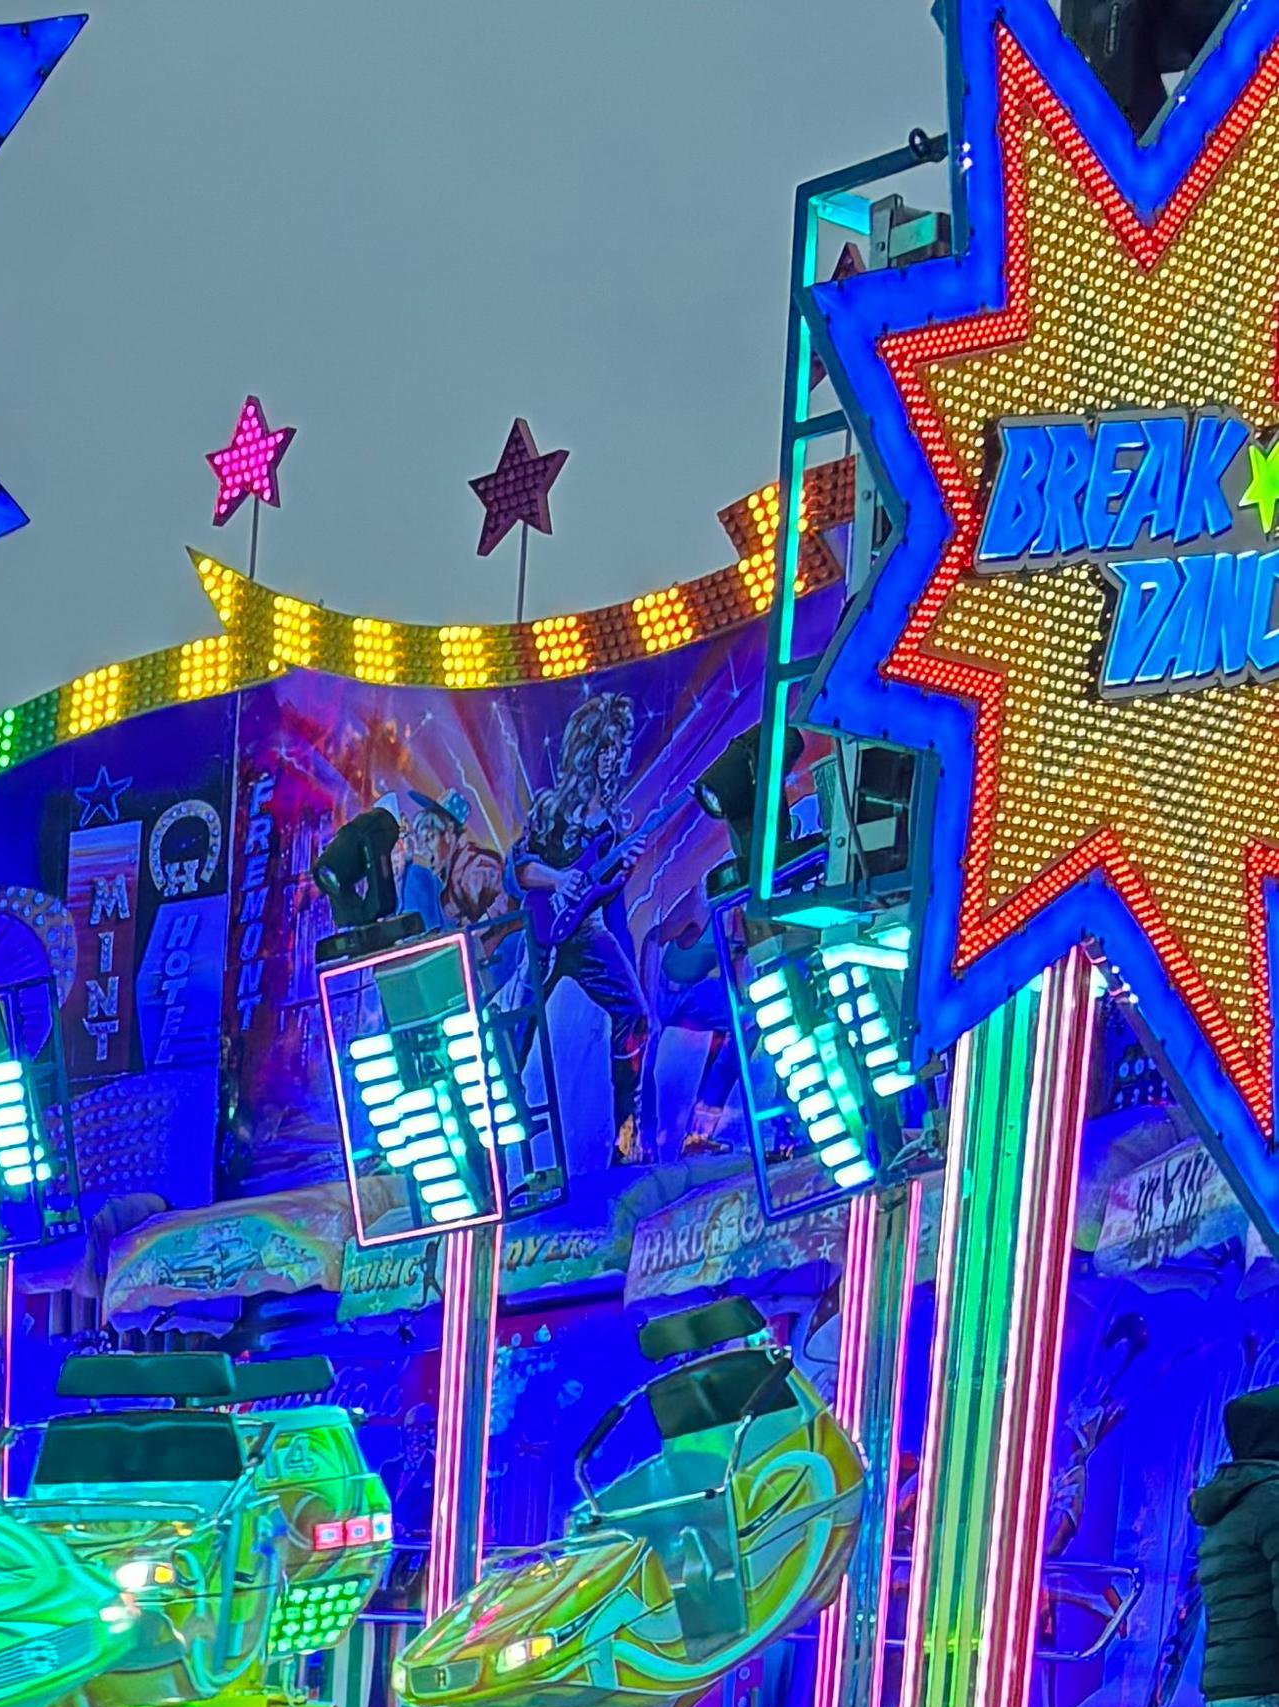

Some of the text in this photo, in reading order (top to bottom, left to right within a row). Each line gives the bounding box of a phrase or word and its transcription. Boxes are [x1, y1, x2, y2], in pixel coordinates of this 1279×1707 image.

[979, 416, 1251, 561] BREAK
[1105, 551, 1279, 688] DANC
[81, 872, 131, 1062] MINT
[153, 914, 199, 1065] HOTEL
